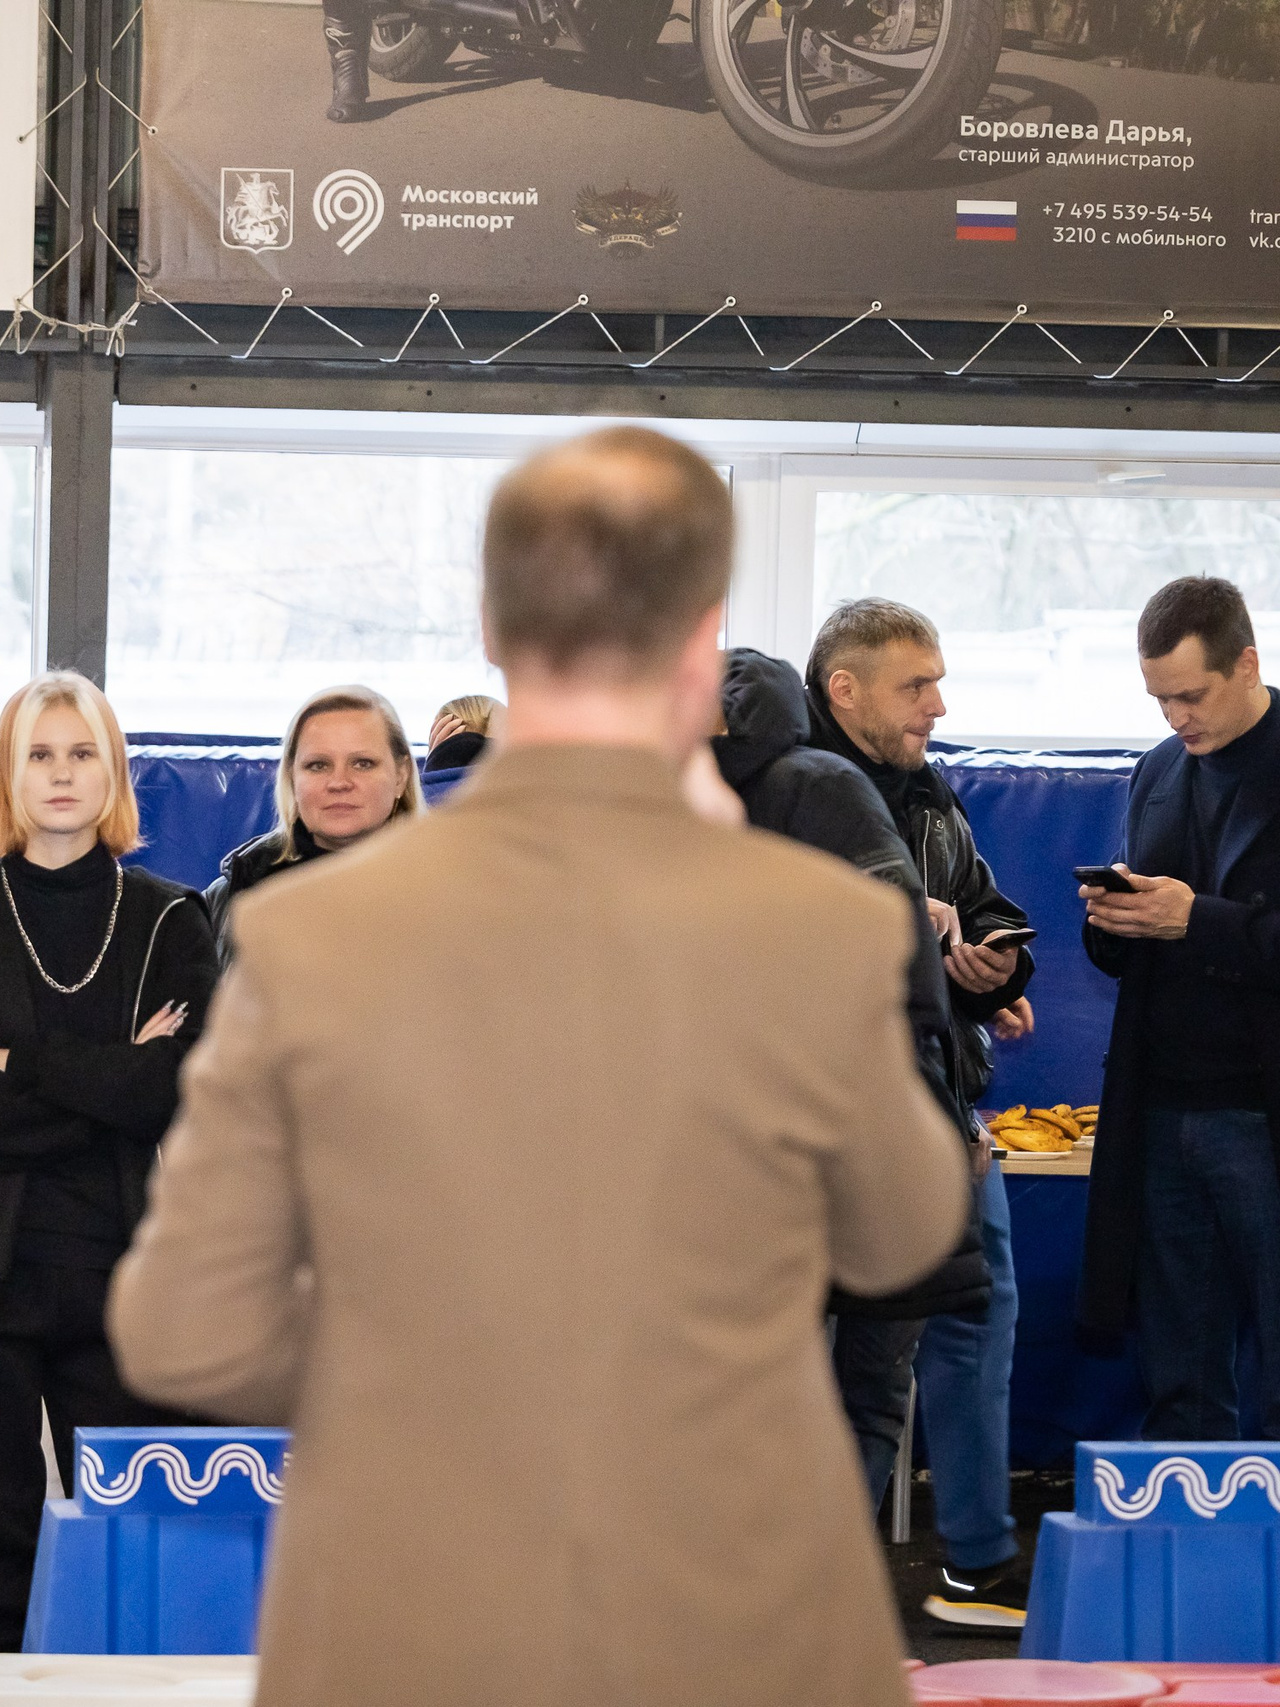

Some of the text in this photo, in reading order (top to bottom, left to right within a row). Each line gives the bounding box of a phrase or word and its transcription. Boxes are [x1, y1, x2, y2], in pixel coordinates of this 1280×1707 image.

[960, 115, 1193, 147] Боровлева Дарья,
[958, 148, 1195, 172] старший администратор
[401, 184, 539, 206] Московский
[400, 212, 515, 233] транспорт
[1042, 202, 1213, 222] +7 495 539-54-54
[1052, 226, 1227, 247] 3210 с мобильного
